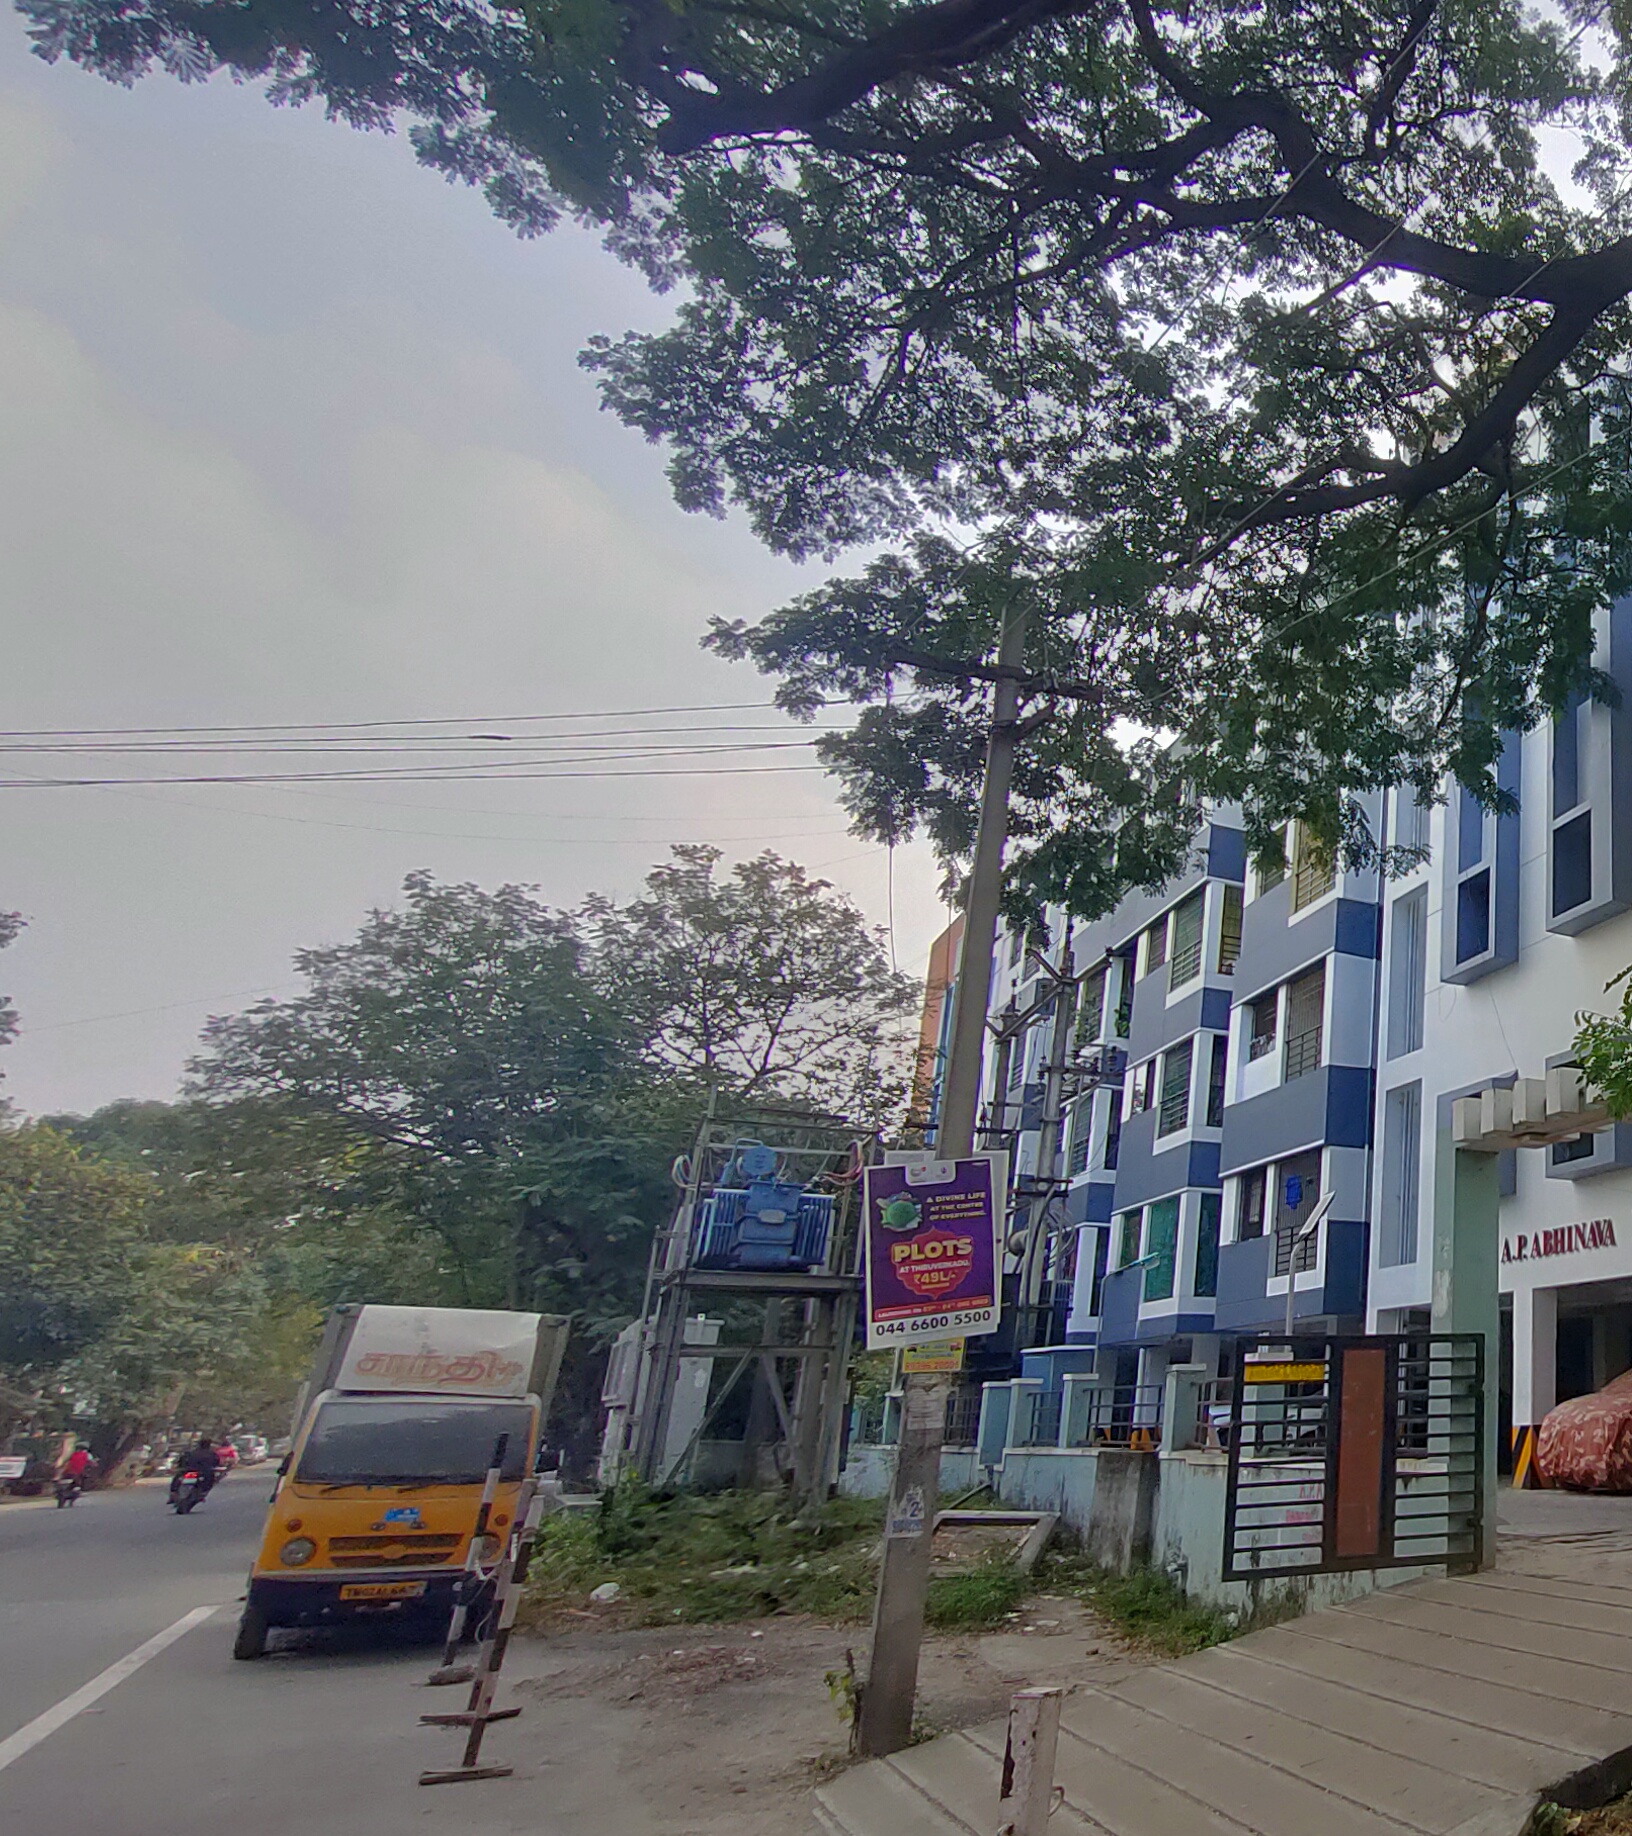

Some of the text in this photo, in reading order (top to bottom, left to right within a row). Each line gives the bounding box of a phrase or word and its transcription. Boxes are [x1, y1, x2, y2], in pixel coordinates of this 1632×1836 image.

[894, 1238, 972, 1263] PLOTS
[1501, 1218, 1617, 1264] A.P. ABHINAVA
[876, 1310, 991, 1337] 044 6600 5500
